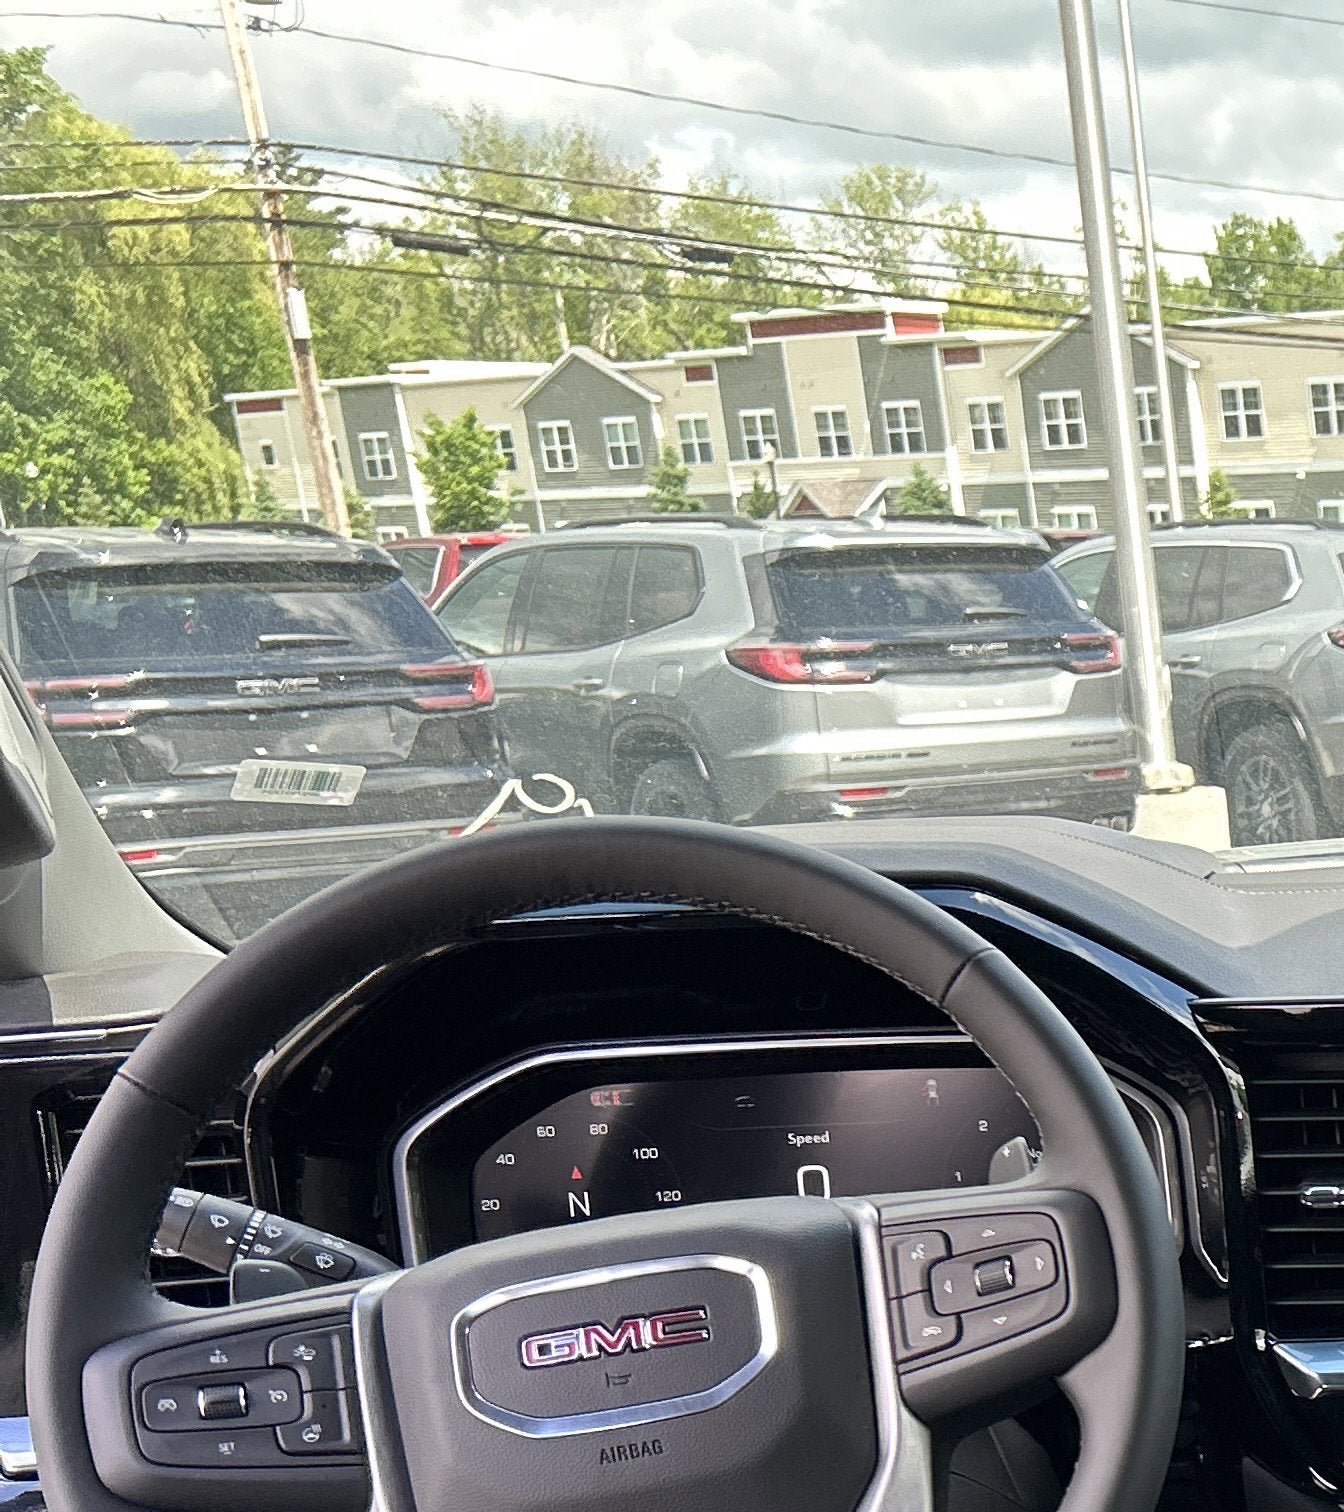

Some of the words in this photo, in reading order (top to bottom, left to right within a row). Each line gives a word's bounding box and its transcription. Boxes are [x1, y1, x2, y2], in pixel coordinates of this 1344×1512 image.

[236, 677, 321, 696] GMC
[536, 1126, 555, 1137] 60
[589, 1124, 608, 1135] 80
[978, 1120, 988, 1132] 2
[787, 1131, 830, 1148] Speed
[496, 1153, 515, 1165] 40
[632, 1148, 658, 1160] 100
[655, 1190, 681, 1202] 120
[481, 1199, 500, 1211] 20
[568, 1191, 591, 1218] N
[520, 1308, 710, 1368] GMC
[600, 1439, 664, 1465] AIRBAG
